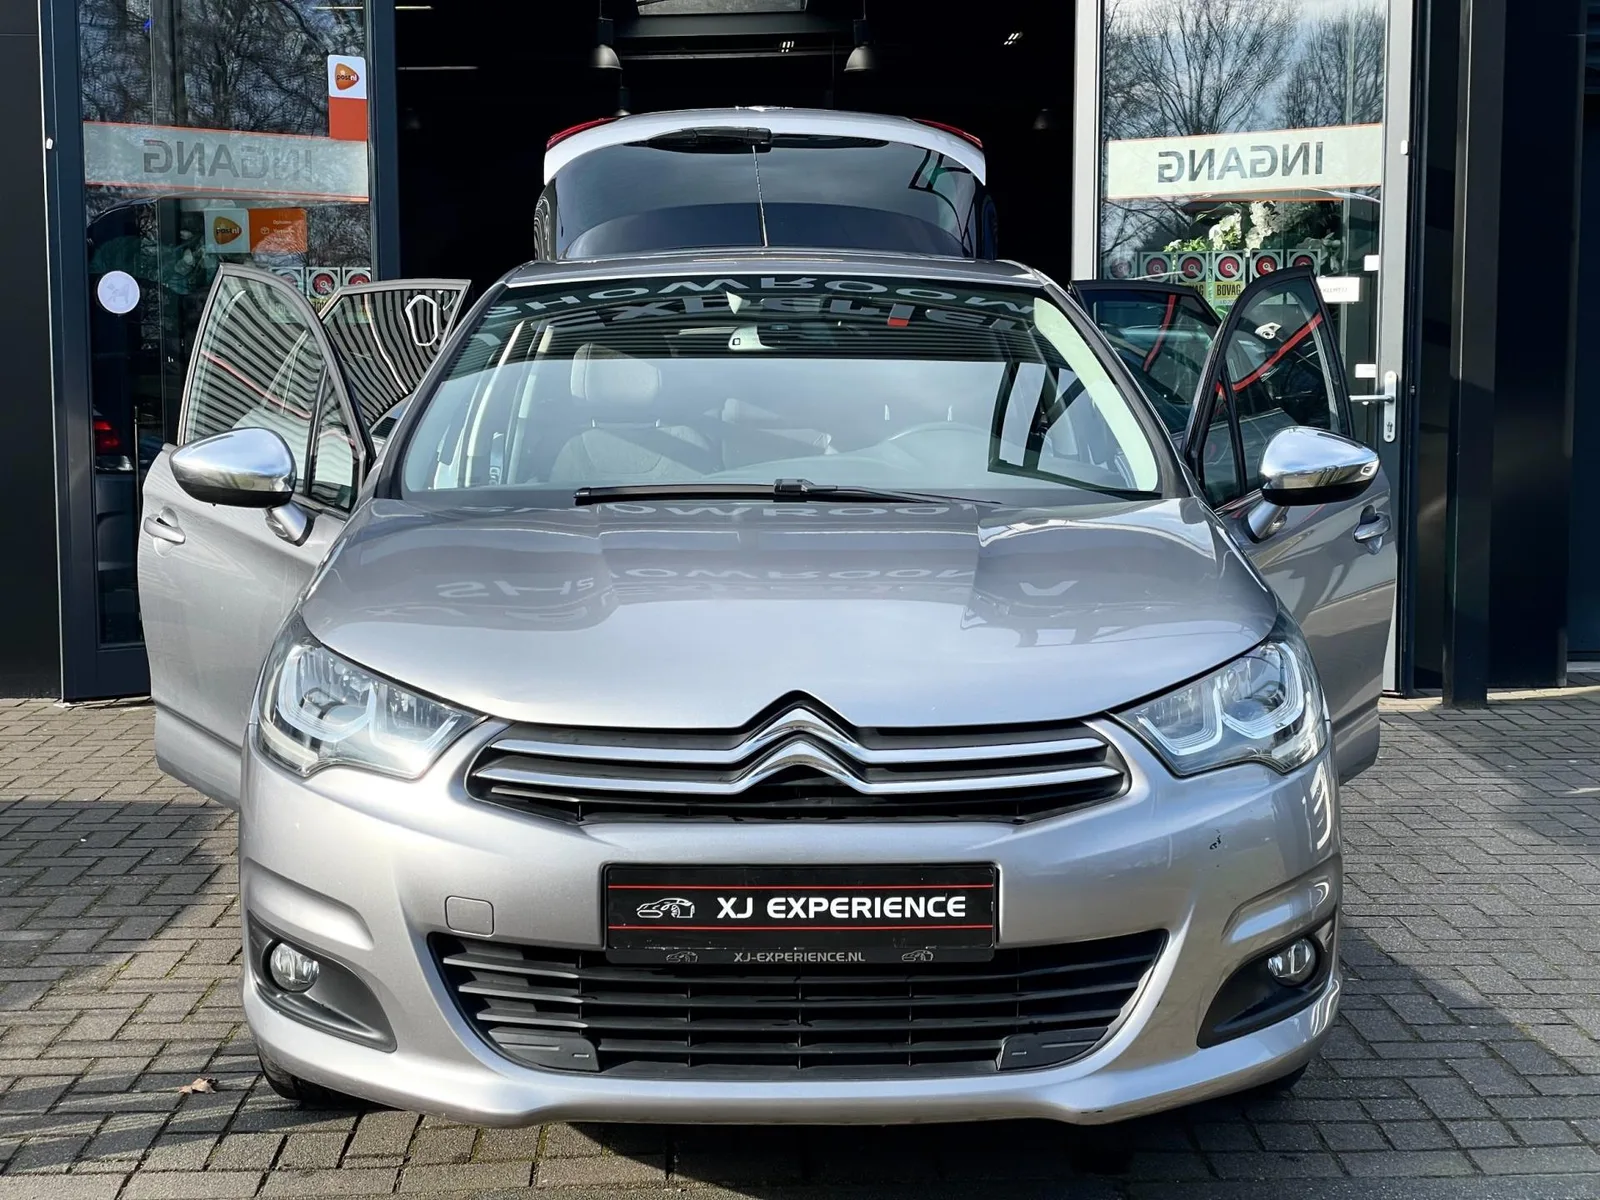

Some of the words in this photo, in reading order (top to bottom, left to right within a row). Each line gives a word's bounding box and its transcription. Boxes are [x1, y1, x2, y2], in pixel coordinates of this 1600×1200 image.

[1216, 284, 1241, 297] BOVAG
[716, 896, 754, 919] XJ
[766, 895, 967, 919] EXPERIENCE
[733, 951, 867, 963] XJ-EXPERIENCE.NL
